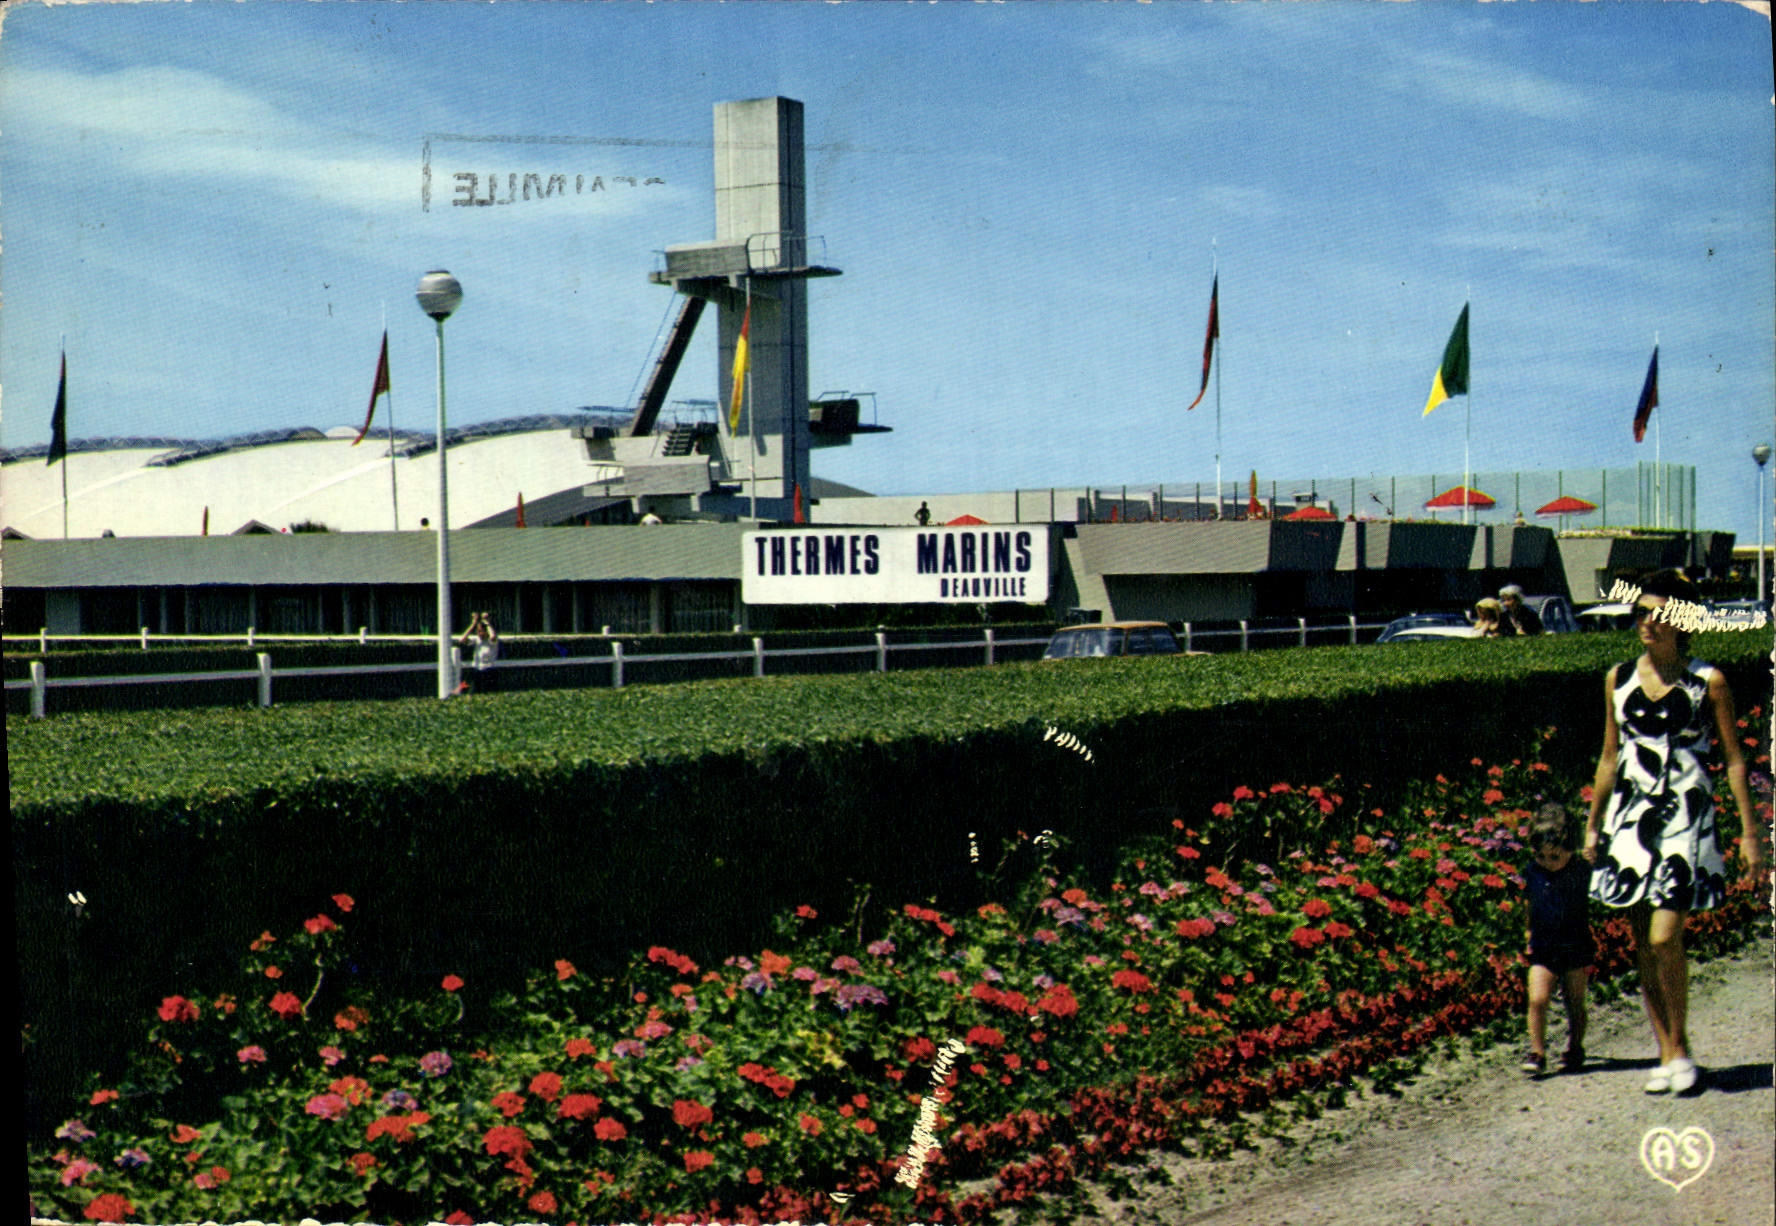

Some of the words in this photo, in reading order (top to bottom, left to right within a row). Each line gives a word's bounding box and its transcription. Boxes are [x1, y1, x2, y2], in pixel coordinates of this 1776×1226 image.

[755, 534, 879, 575] THERMES
[917, 531, 1031, 574] MARINS
[940, 577, 1026, 598] DEAUVILLE
